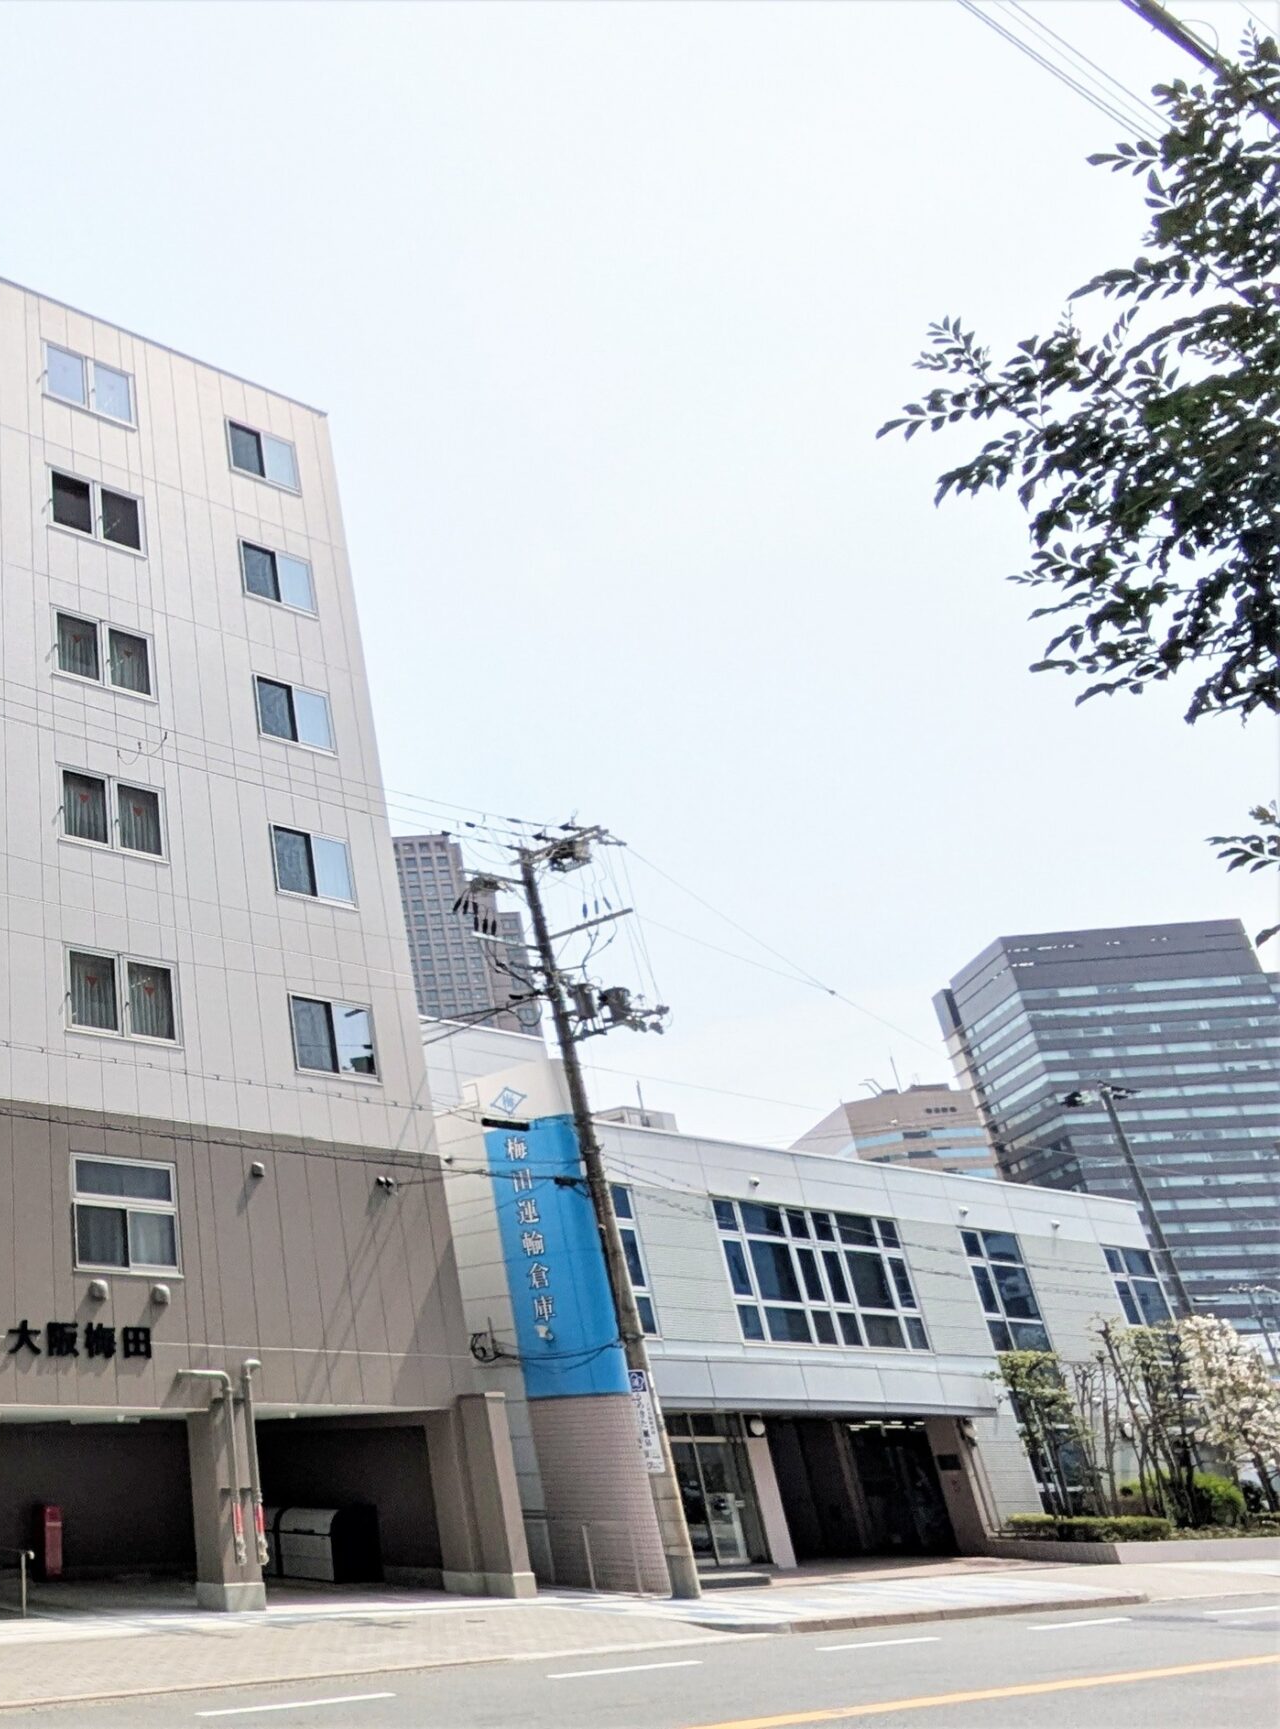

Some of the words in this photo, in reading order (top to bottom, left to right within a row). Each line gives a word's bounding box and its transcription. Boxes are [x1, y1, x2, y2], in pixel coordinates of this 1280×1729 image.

[505, 1135, 556, 1322] 梅田運輸倉庫
[7, 1319, 153, 1359] 大阪梅田
